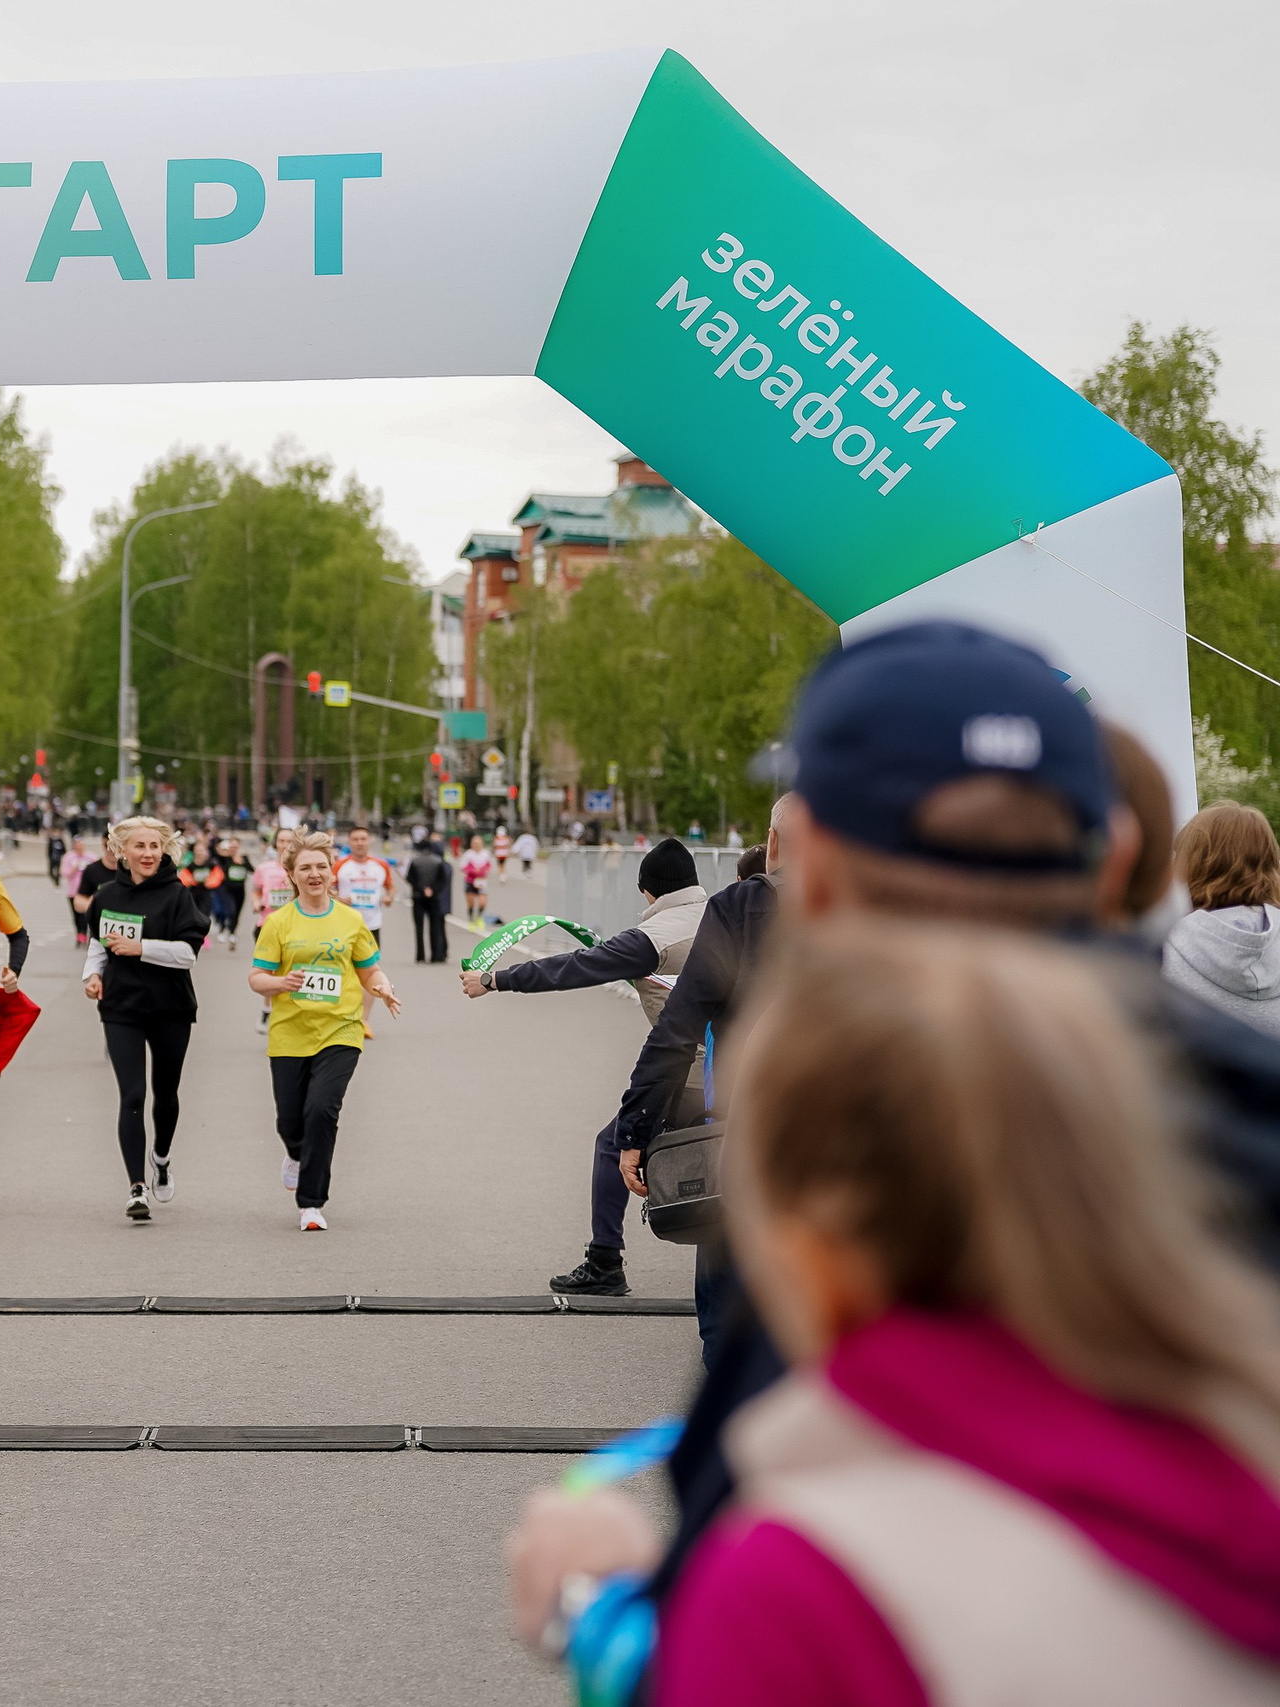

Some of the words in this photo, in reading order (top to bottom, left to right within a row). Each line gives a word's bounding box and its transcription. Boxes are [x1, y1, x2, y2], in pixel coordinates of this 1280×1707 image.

[655, 275, 913, 497] марафон
[701, 231, 967, 451] зелёный
[103, 922, 136, 939] 1413
[305, 975, 336, 991] 410
